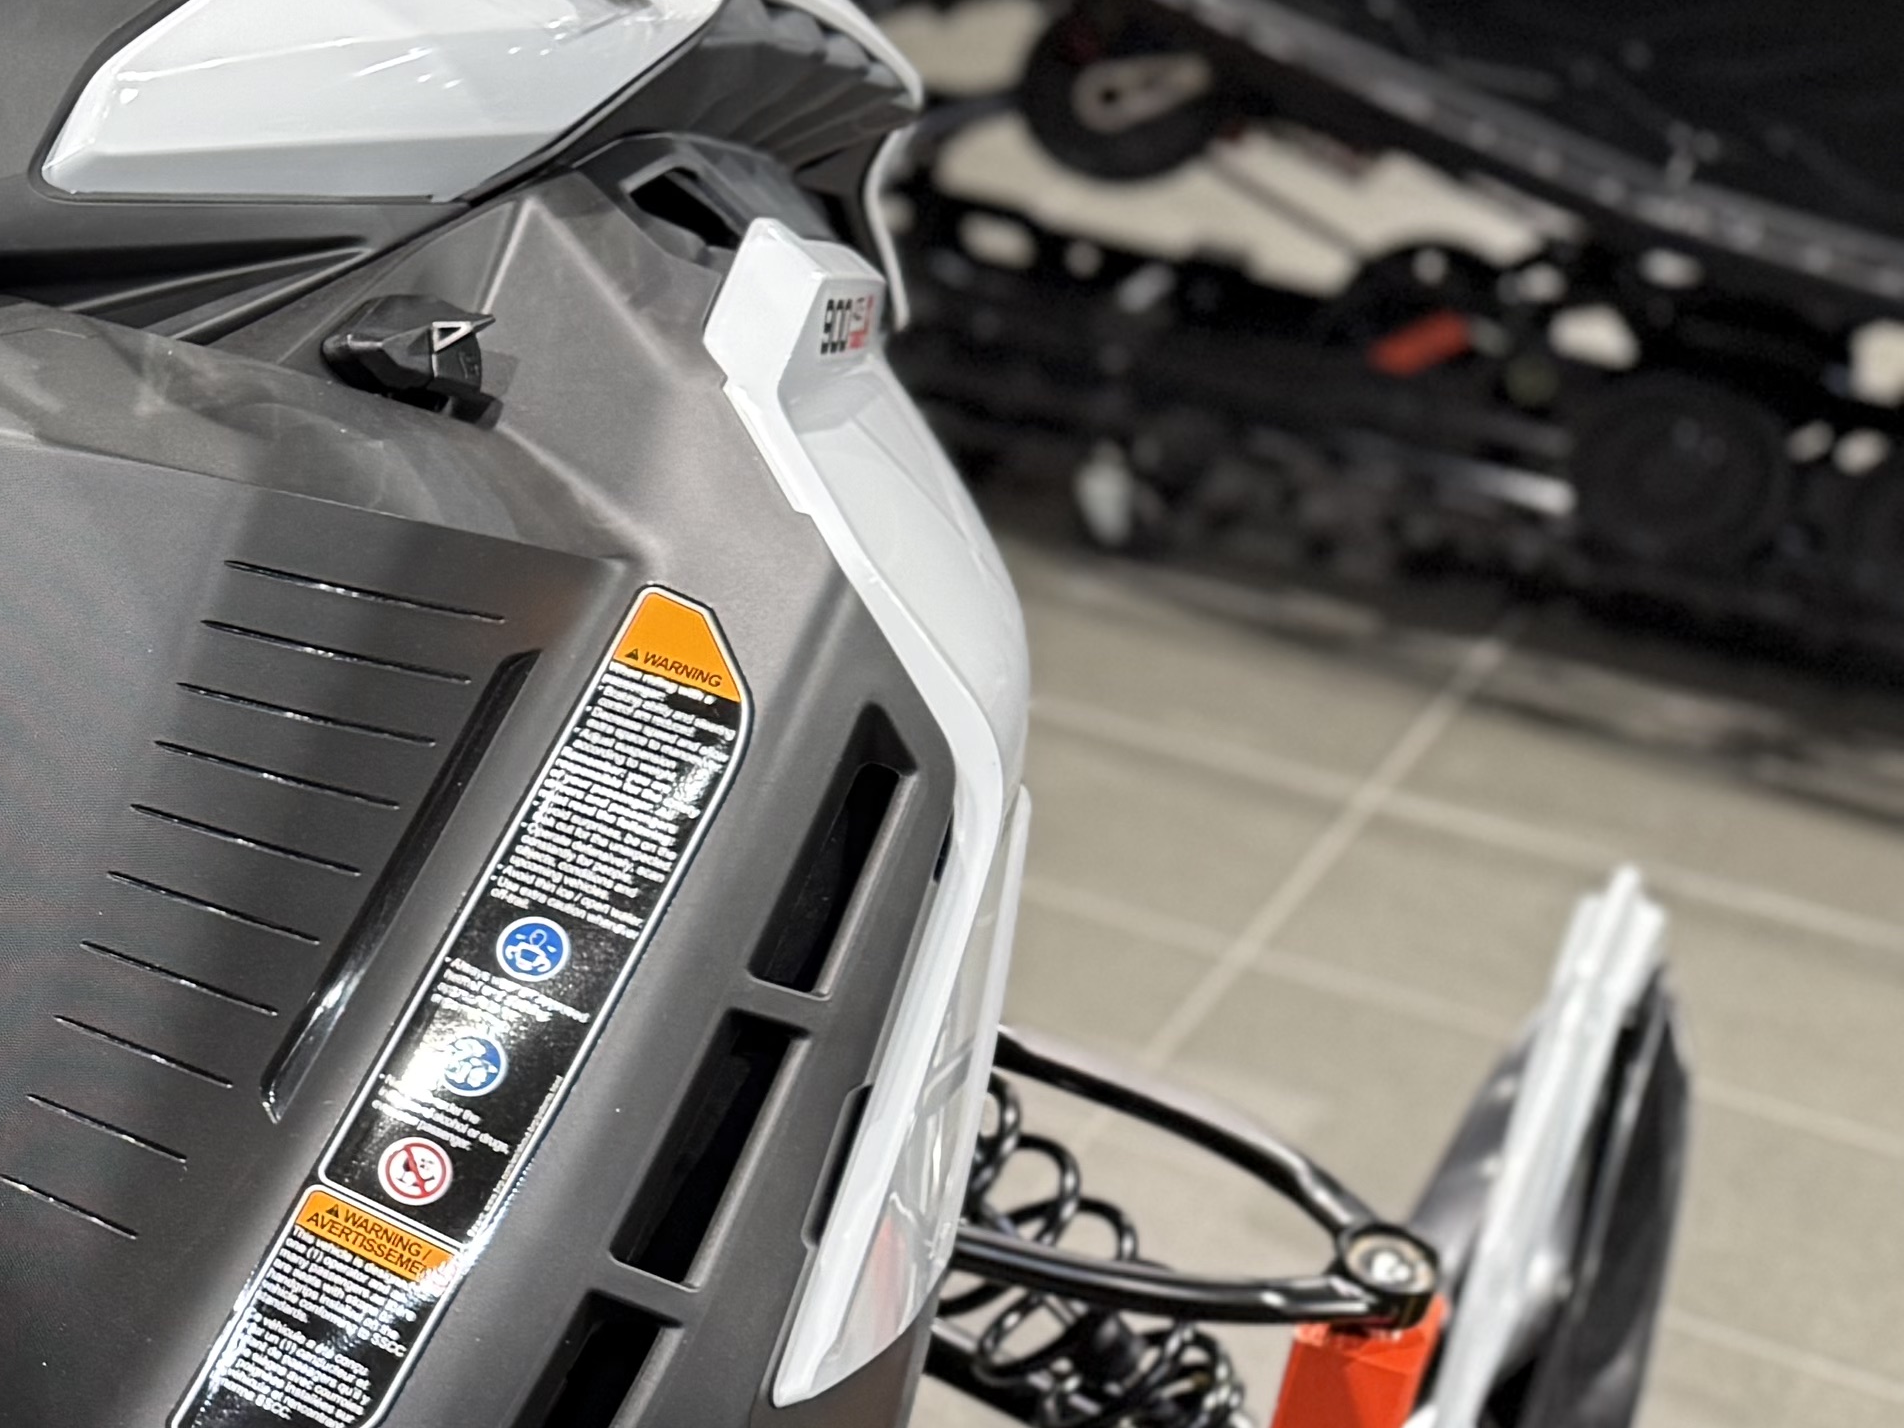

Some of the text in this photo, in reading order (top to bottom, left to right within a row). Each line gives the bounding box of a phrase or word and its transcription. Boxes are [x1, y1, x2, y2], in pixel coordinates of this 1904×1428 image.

[642, 651, 723, 688] WARNING
[675, 736, 701, 752] and
[588, 833, 610, 847] the
[639, 840, 657, 853] on
[655, 845, 678, 861] the
[495, 875, 521, 893] Use
[517, 885, 548, 904] extra
[545, 895, 588, 919] caution
[501, 864, 536, 885] Avoid
[533, 876, 557, 893] thin
[554, 884, 576, 900] ice
[578, 895, 611, 916] open
[612, 880, 639, 899] and
[304, 1211, 442, 1286] AVERTISSEME
[339, 1208, 425, 1258] WARNING
